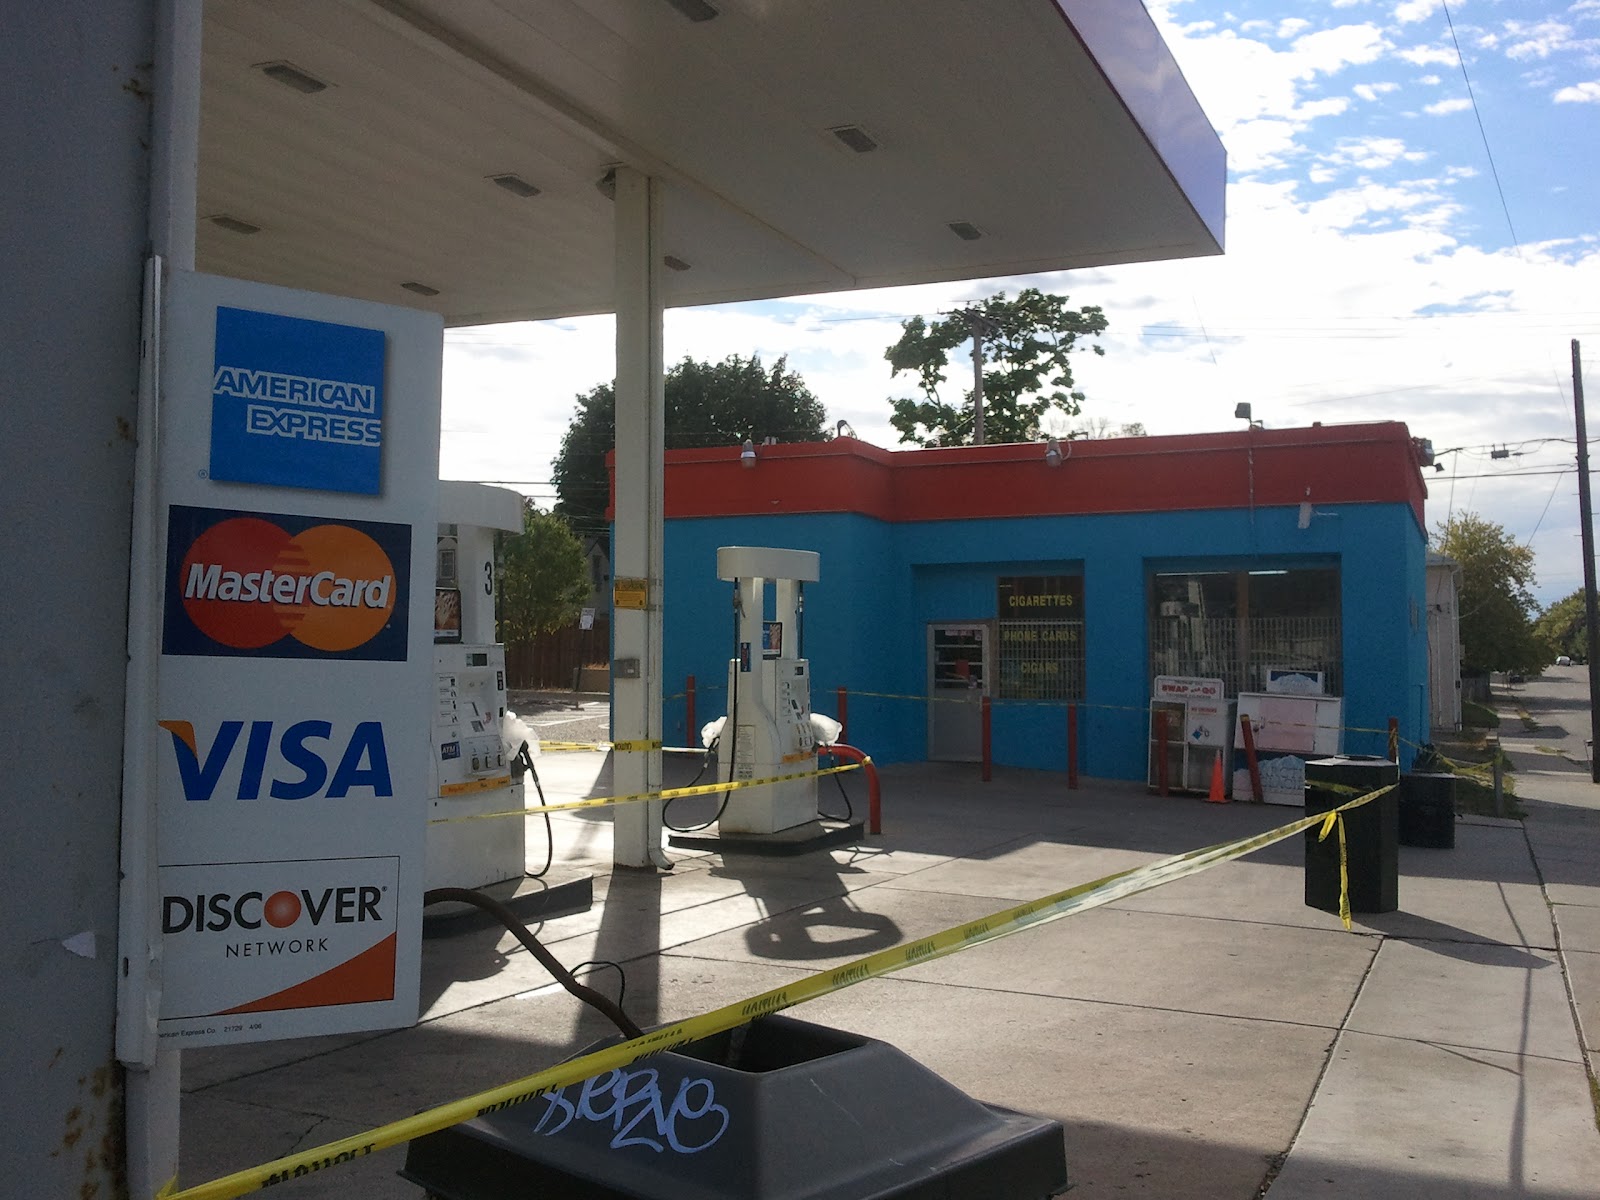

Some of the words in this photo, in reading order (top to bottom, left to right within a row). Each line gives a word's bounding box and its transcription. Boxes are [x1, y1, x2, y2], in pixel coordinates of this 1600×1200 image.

[213, 366, 376, 414] AMERICAN
[247, 405, 382, 447] EXPRESS
[184, 563, 392, 609] MasterCard
[484, 561, 493, 596] 3
[1008, 594, 1073, 607] CIGARETTES
[1003, 630, 1038, 641] PHONE
[1042, 630, 1077, 641] CARDS
[1161, 684, 1189, 693] SWAP
[158, 720, 393, 801] VISA
[162, 886, 383, 934] DISCOVER
[226, 938, 328, 958] NETWORK
